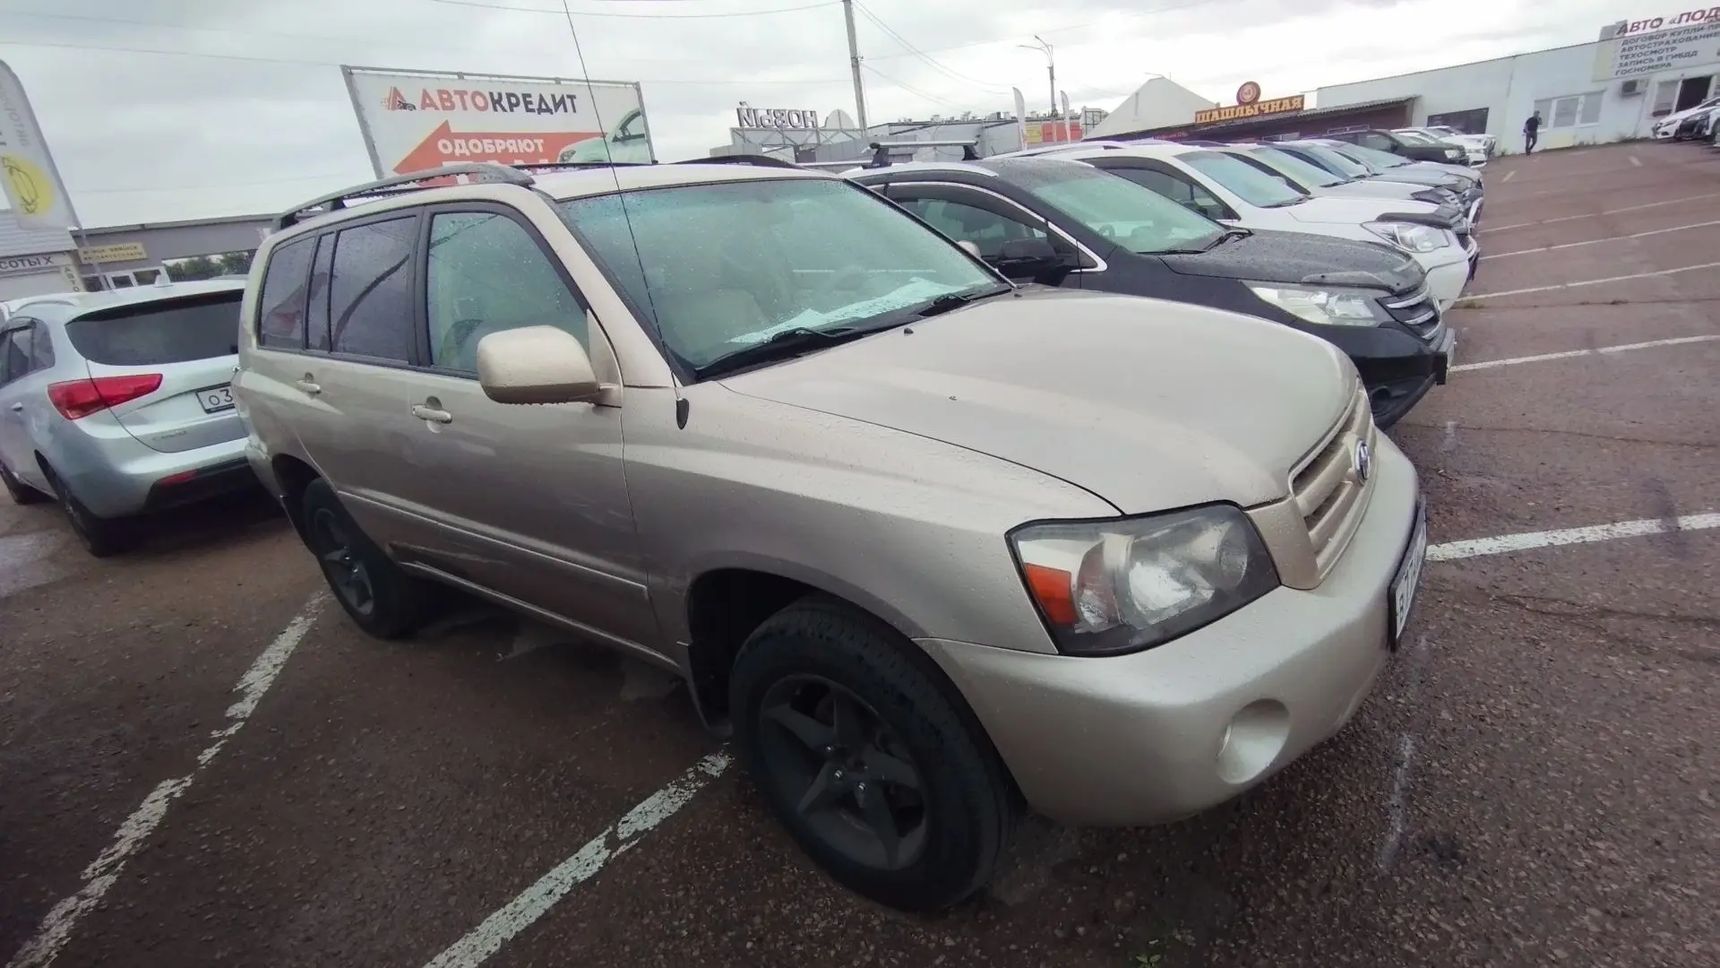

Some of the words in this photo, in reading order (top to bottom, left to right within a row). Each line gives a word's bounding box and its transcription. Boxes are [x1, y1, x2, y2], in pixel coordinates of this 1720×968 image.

[1616, 17, 1664, 35] АВТО
[1621, 33, 1668, 46] ДОГОВОР
[1620, 46, 1677, 60] ТЕХОСМОТР
[1615, 62, 1672, 76] ГОСНОМЕРА
[1618, 58, 1655, 68] ЗАПИСЬ
[420, 89, 577, 115] АВТОКРЕДИТ
[1196, 97, 1303, 123] ШАШЛЫЧНАЯ
[437, 138, 544, 157] ОДОБРЯЮТ
